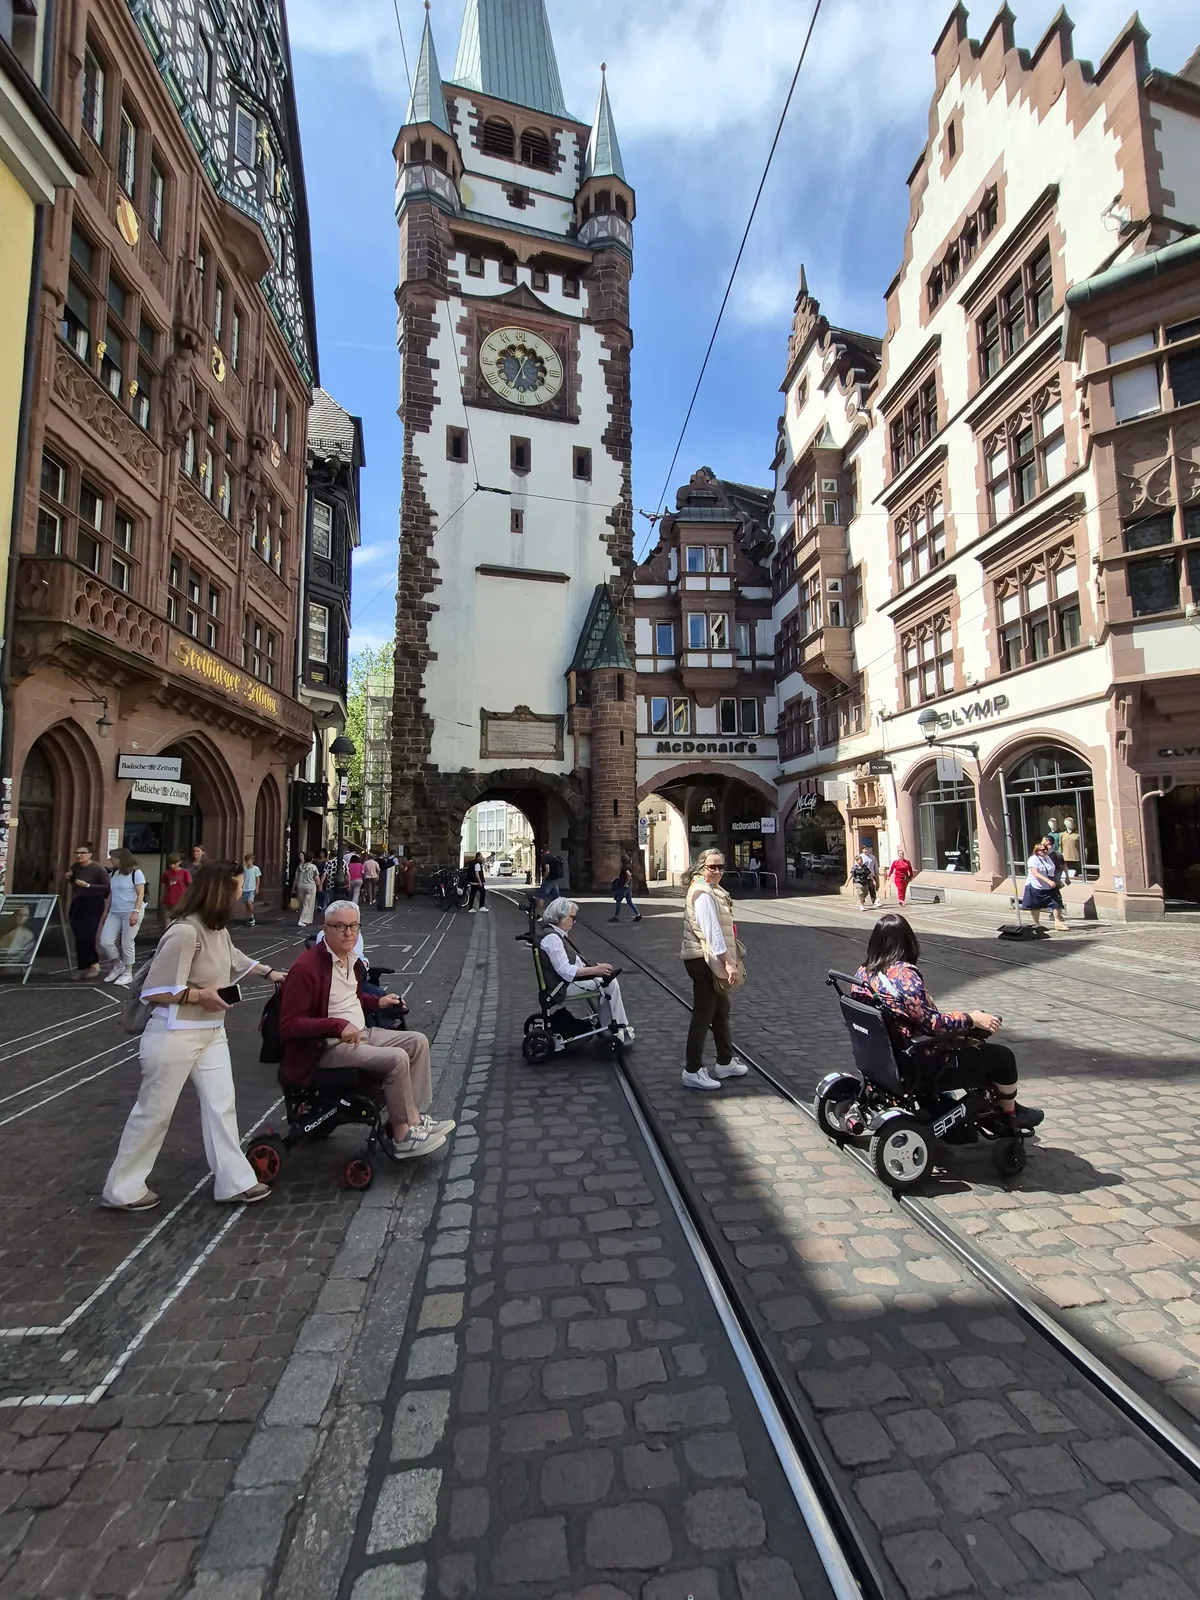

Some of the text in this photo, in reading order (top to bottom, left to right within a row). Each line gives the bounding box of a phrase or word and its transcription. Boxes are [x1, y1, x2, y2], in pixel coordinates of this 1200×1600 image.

[656, 741, 758, 754] McDonald's
[1158, 745, 1200, 758] OLY
[121, 762, 179, 772] Badische Zeitung
[134, 781, 189, 801] Badische Zeitung
[691, 824, 713, 832] McDonald's
[731, 821, 760, 831] McDonald's
